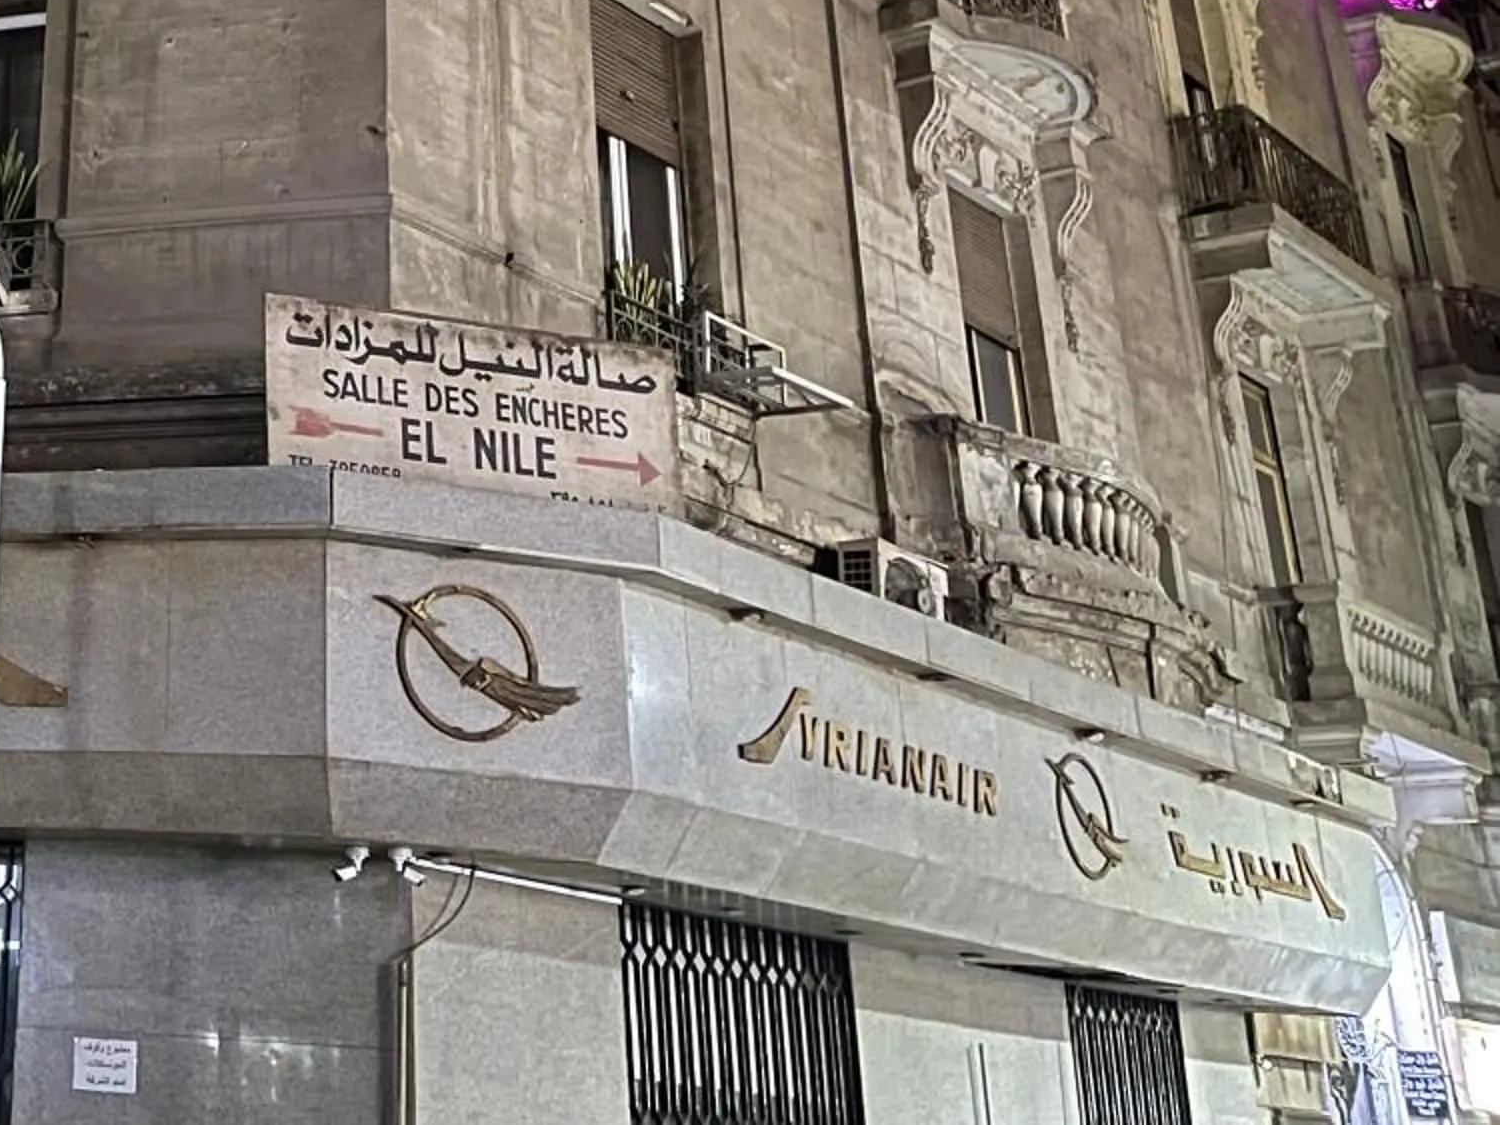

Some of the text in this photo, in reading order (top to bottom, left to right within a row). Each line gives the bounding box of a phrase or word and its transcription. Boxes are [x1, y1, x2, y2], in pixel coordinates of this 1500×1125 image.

[286, 312, 657, 394] صالة النيل للمزادات
[323, 369, 628, 439] SALLE DES ENCHERES
[402, 418, 557, 479] EL NILE
[738, 686, 997, 816] SYRIANAIR
[1161, 802, 1346, 922] السورية
